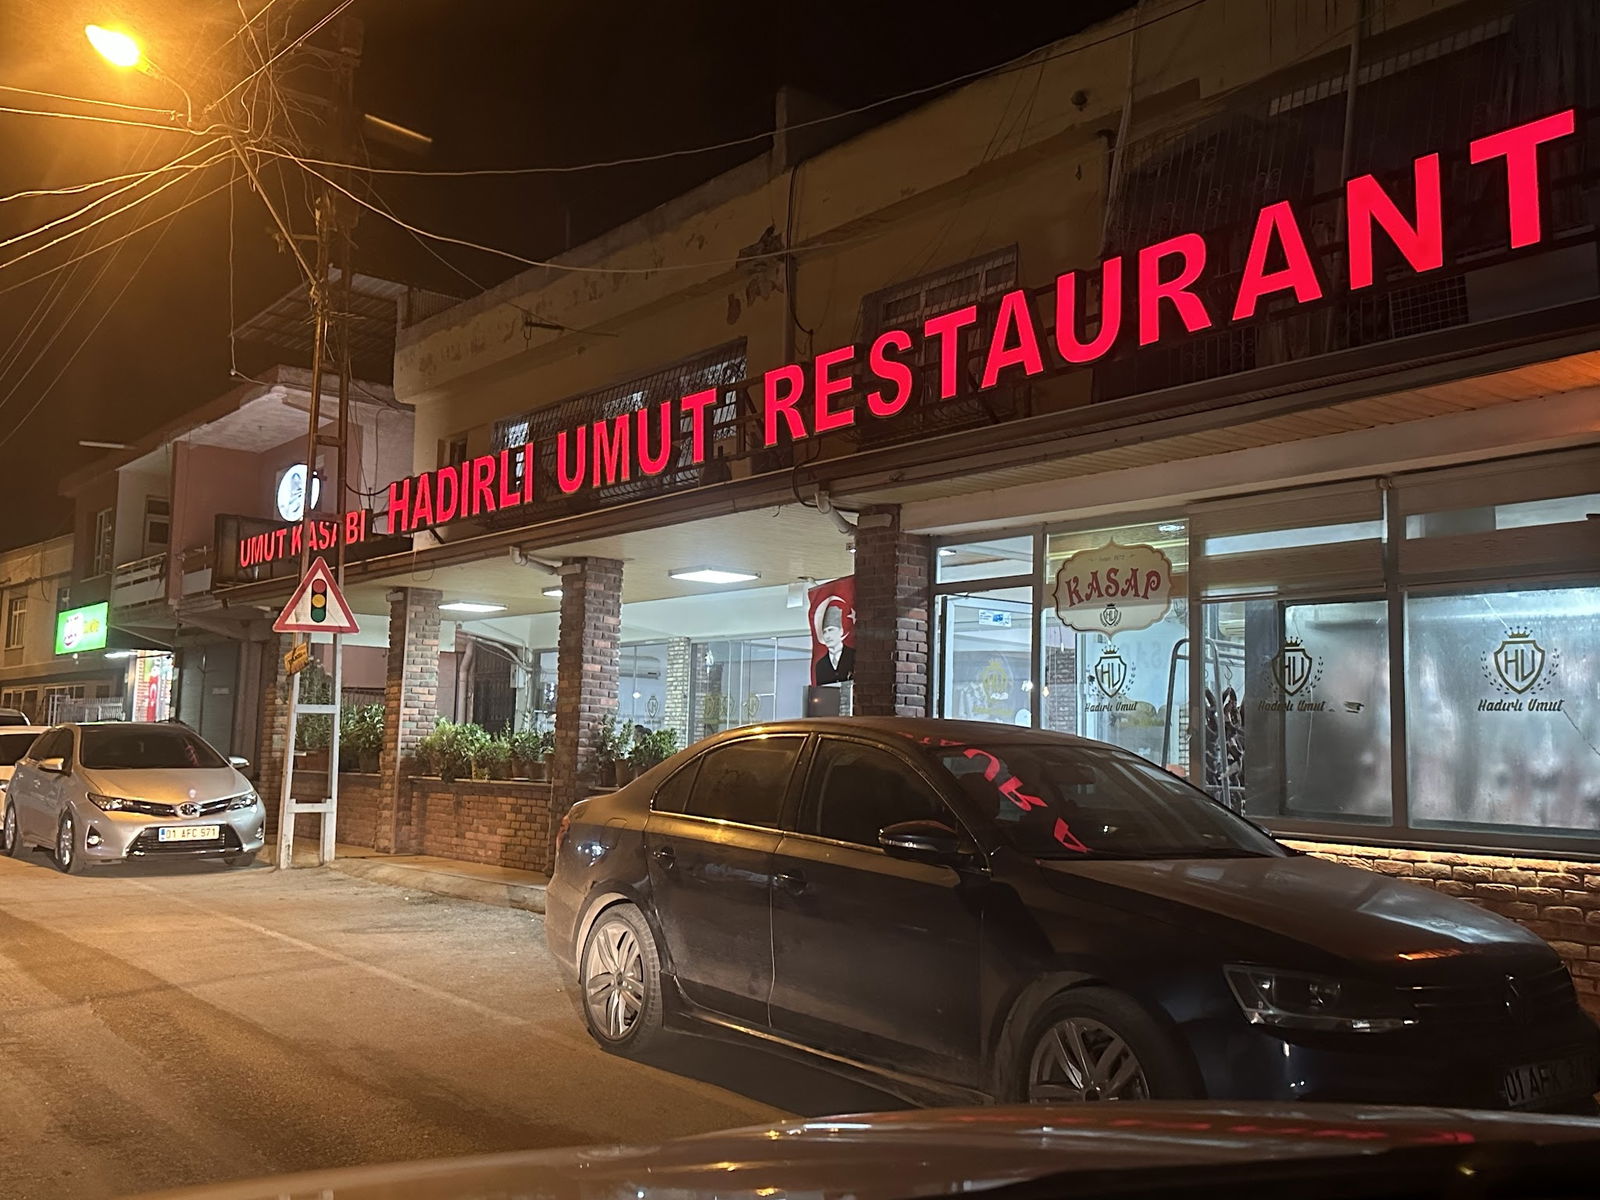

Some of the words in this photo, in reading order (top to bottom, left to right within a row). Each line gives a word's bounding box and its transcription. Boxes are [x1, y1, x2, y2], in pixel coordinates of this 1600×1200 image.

[387, 442, 534, 534] HADIRLI
[557, 388, 717, 494] UMUT
[764, 109, 1578, 447] RESTAURANT
[240, 529, 287, 568] UMUT
[1065, 567, 1161, 608] KASAP
[1115, 701, 1138, 712] Umut
[1527, 699, 1565, 712] Umut
[166, 829, 176, 839] 01
[181, 828, 197, 838] AFC
[200, 828, 216, 838] 571
[1504, 1070, 1525, 1102] 01
